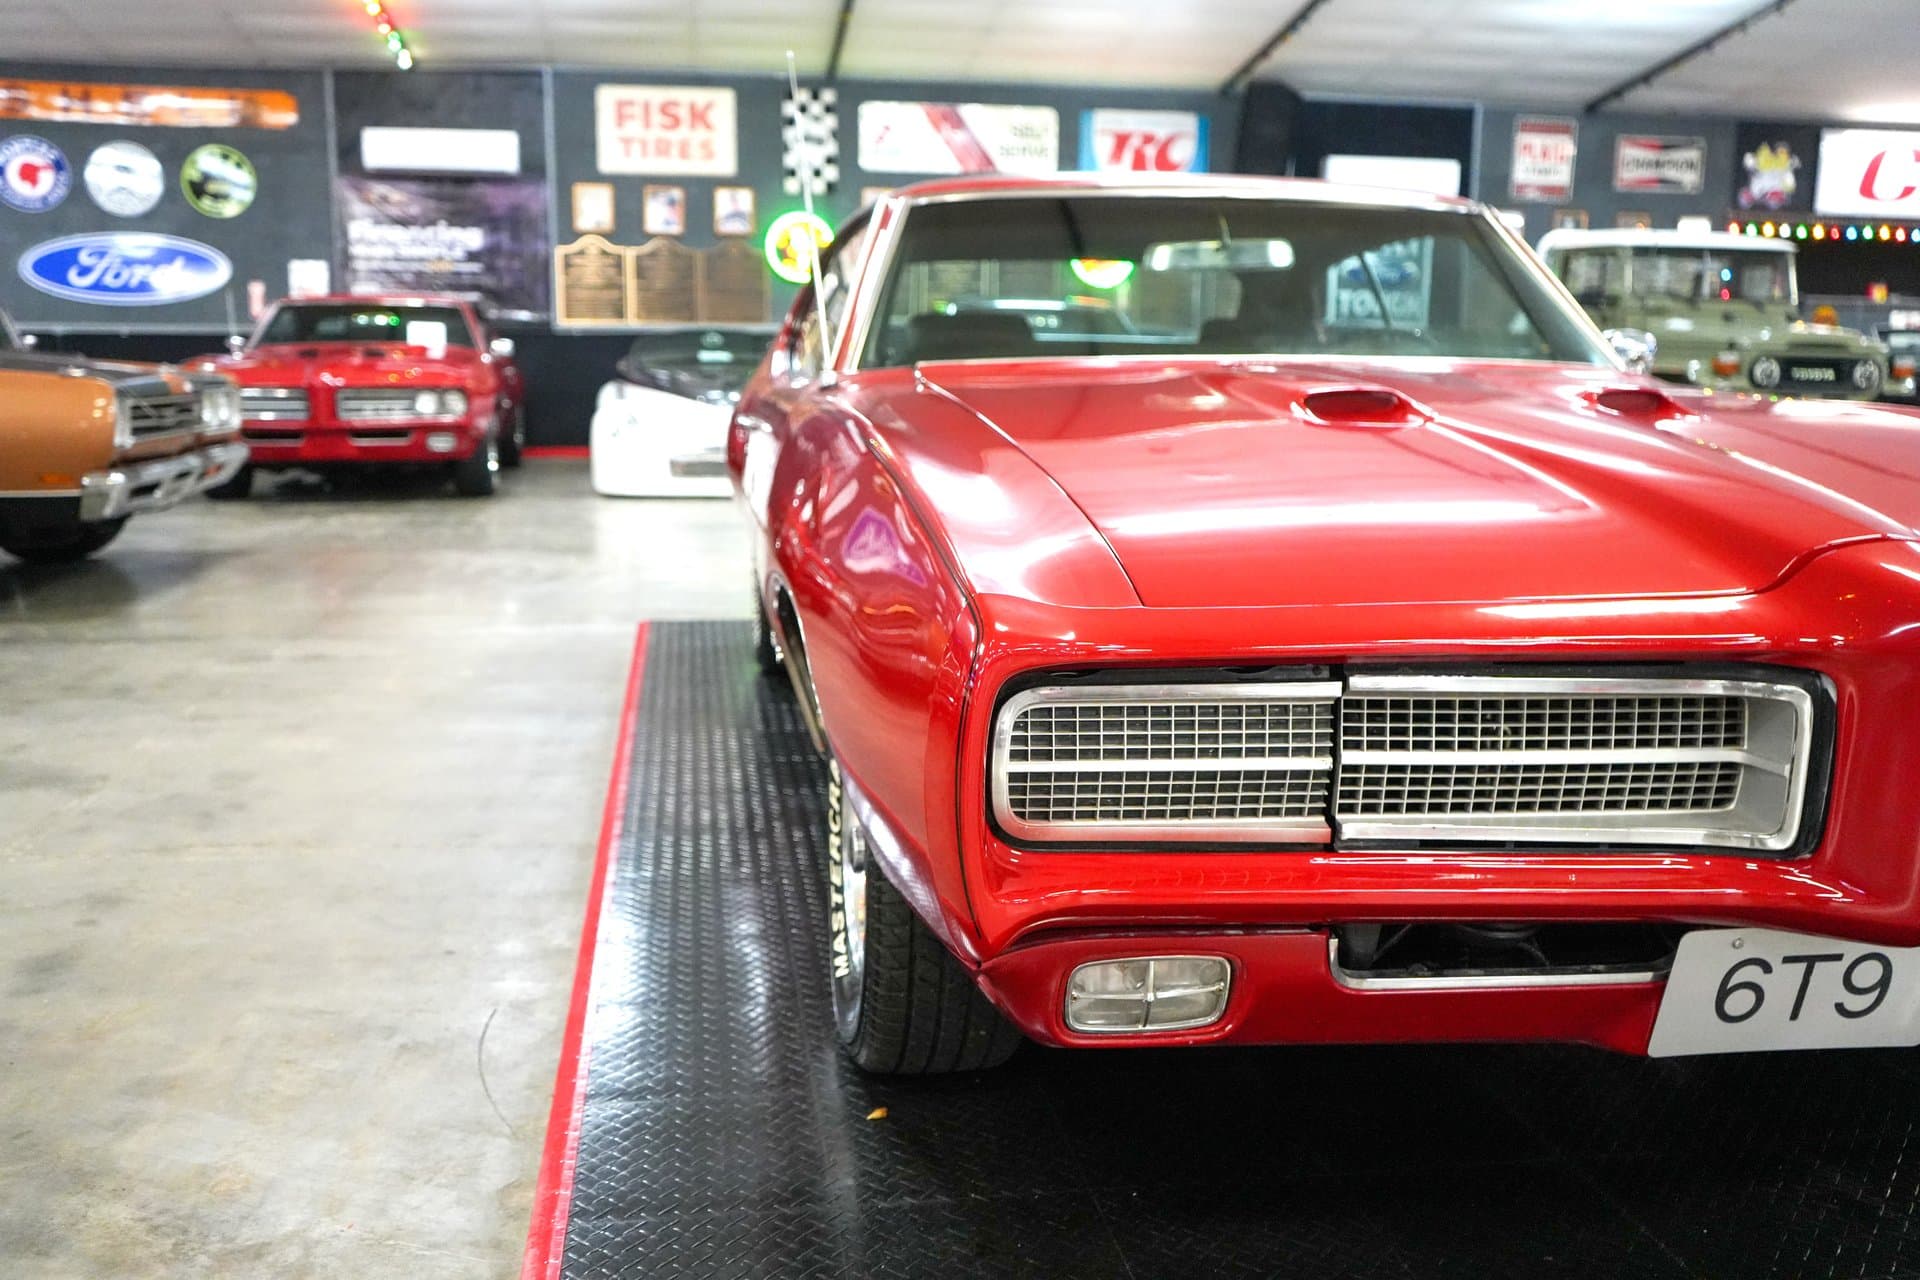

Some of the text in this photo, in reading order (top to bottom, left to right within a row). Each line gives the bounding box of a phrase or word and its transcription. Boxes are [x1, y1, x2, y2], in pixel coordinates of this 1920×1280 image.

[613, 98, 716, 131] FISK
[617, 136, 716, 160] TIRES
[67, 246, 190, 289] Ford
[1714, 952, 1893, 1024] 6T9
